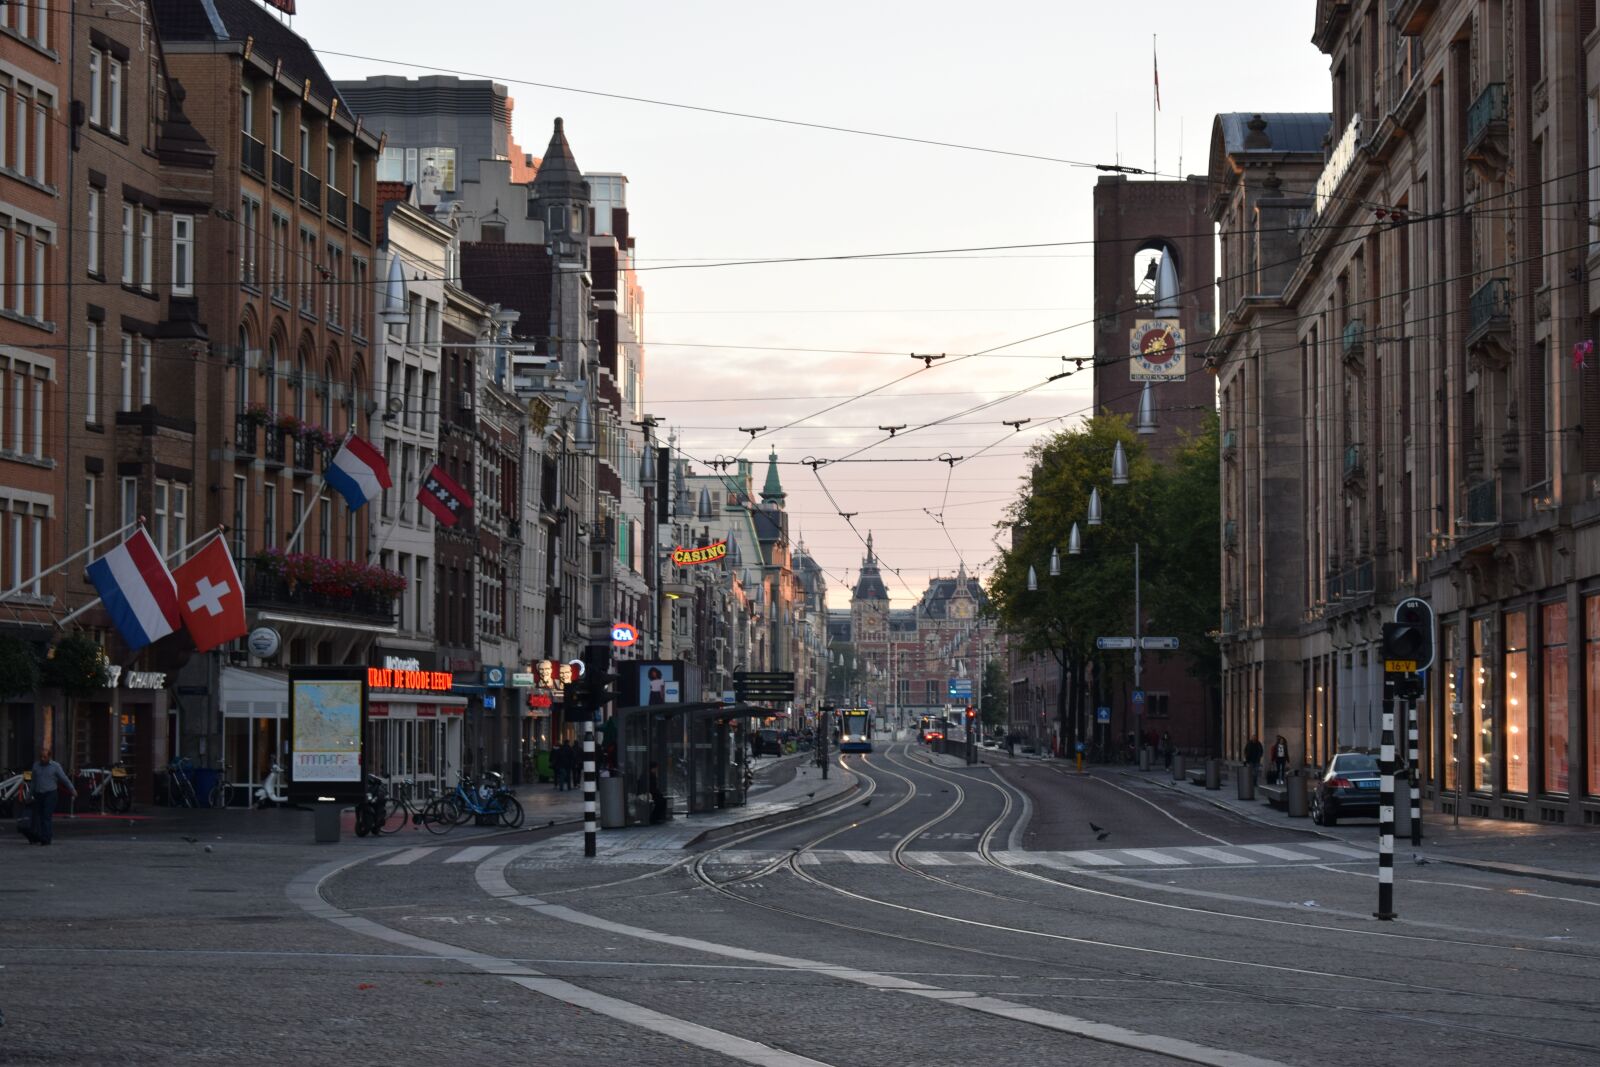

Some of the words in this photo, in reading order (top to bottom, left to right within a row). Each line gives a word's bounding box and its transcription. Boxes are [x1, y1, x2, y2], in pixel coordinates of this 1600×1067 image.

[674, 544, 726, 562] CASINO
[128, 671, 167, 690] CHANGE
[394, 670, 404, 688] DE
[405, 671, 430, 689] ROODE
[431, 672, 453, 690] LEEUW
